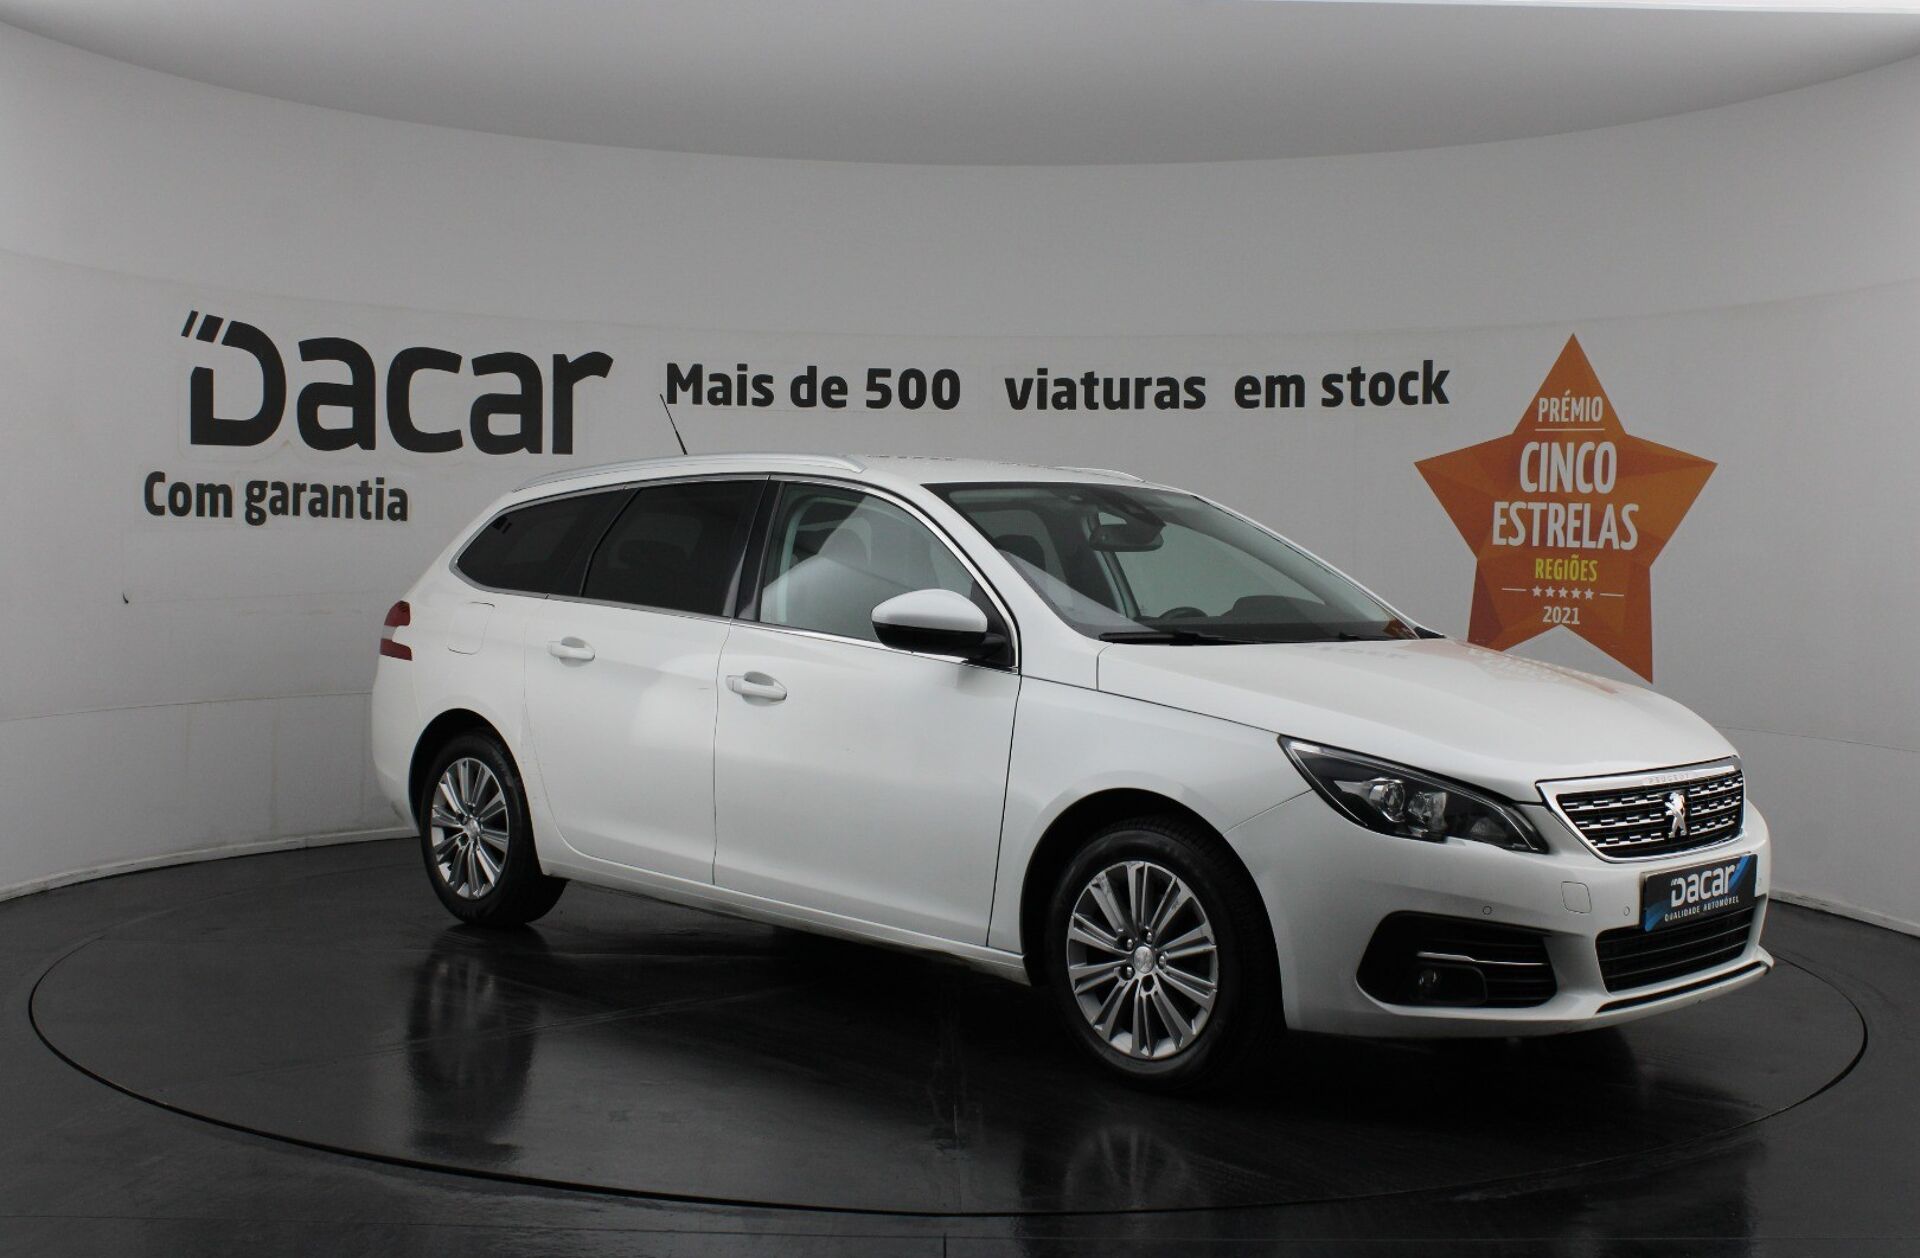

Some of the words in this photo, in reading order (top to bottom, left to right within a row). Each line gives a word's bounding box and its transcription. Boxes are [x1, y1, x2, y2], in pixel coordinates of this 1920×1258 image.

[181, 310, 614, 456] Dacar
[666, 363, 775, 406] Mais
[790, 365, 849, 408] de
[865, 367, 961, 411] 500
[1004, 367, 1206, 411] viaturas
[1234, 374, 1306, 408] em
[1321, 359, 1450, 408] stock
[1537, 388, 1604, 423] PRÉMIO
[1519, 441, 1618, 494] CINCO
[143, 470, 233, 519] Com
[244, 476, 409, 527] garantia
[1492, 500, 1639, 551] ESTRELAS
[1535, 553, 1598, 582] REGIÕES
[1542, 606, 1581, 625] 2021
[1671, 863, 1737, 908] Dacar
